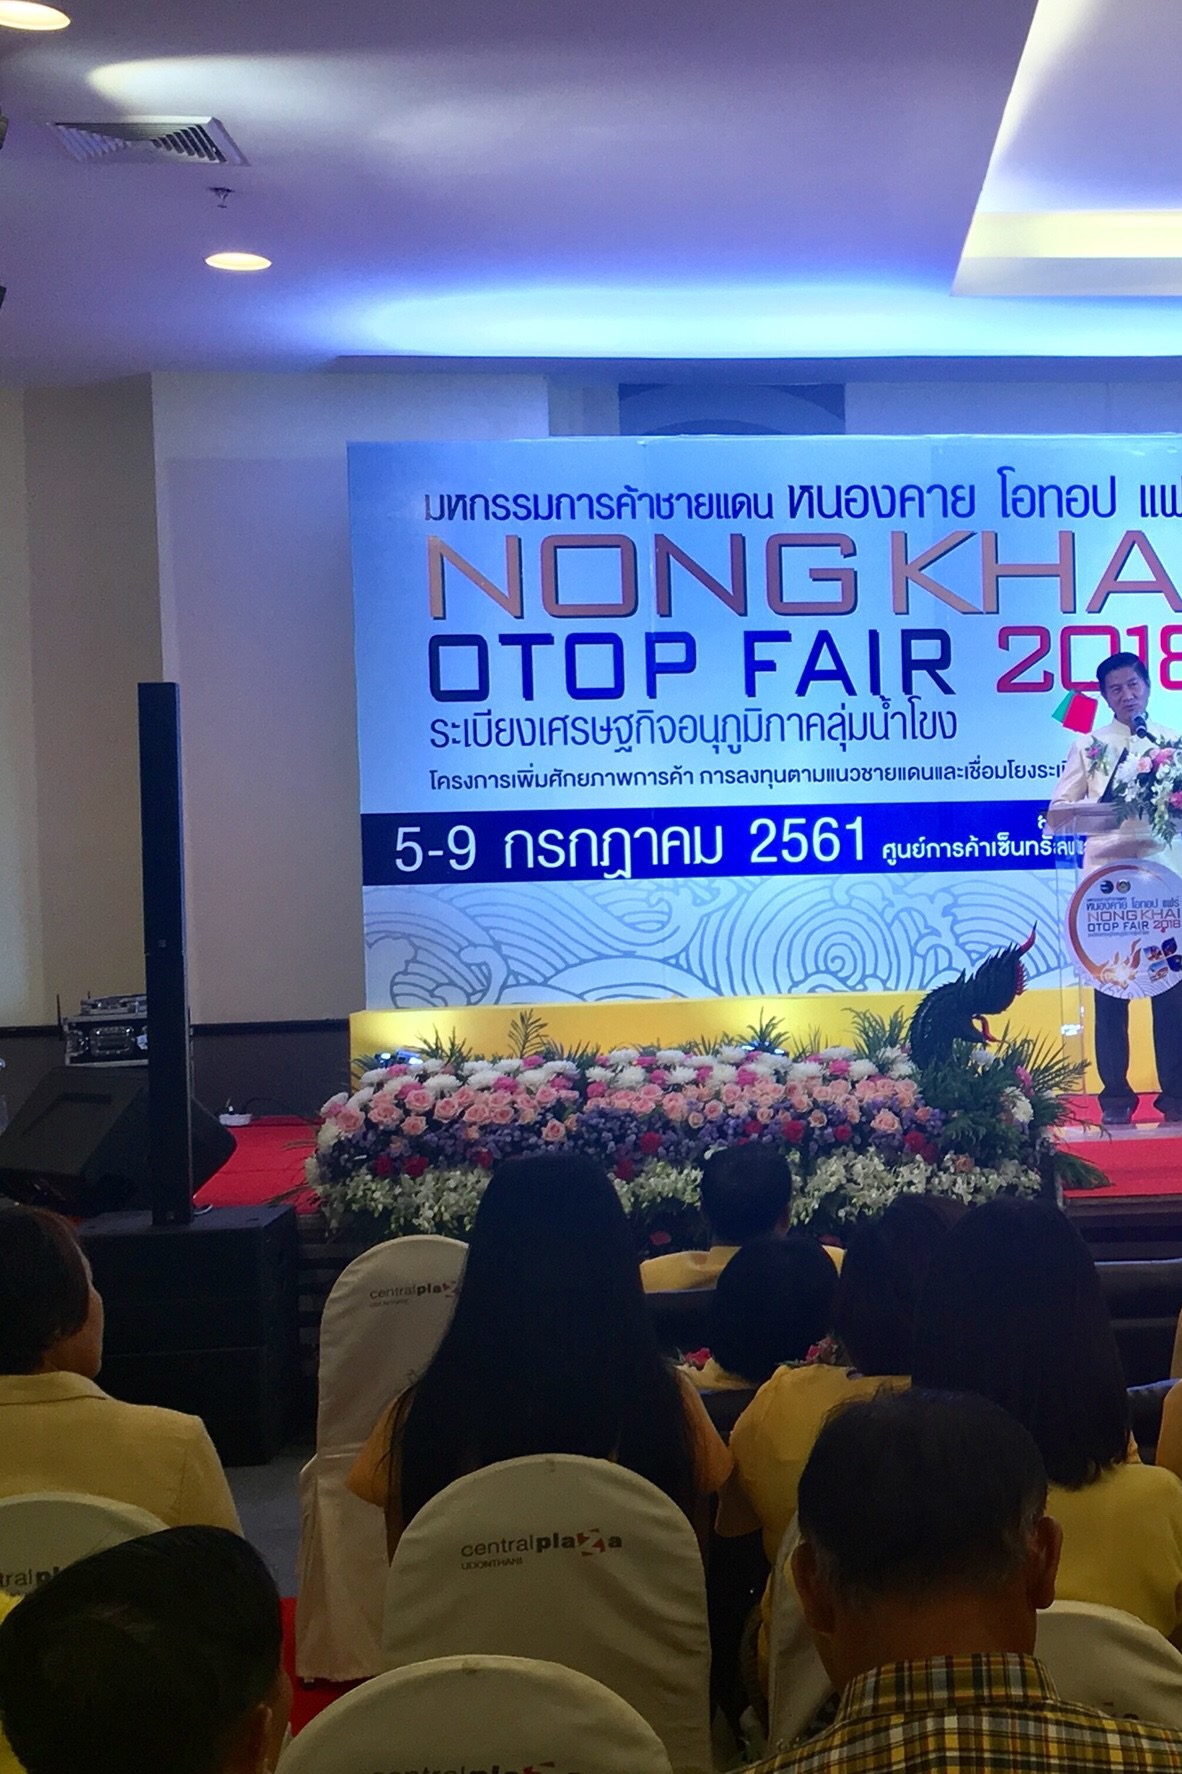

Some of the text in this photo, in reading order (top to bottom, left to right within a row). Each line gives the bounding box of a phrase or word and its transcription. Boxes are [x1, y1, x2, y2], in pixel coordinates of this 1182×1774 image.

[424, 485, 774, 521] มหกรรมการค้าชายแดน
[788, 483, 976, 519] หนองคาย
[997, 466, 1117, 519] โอทอป
[427, 532, 859, 620] NONG
[428, 630, 697, 702] OTOP
[743, 628, 956, 698] FAIR
[430, 695, 957, 754] ระเบียงเศรษฐกิจอนุภูมิภาคลุ่มน้ำโขง
[429, 763, 694, 790] โครงการเพิ่มศักยภาพการค้า
[394, 824, 477, 872] 5-9
[503, 823, 725, 879] กรกฎาคม
[749, 815, 866, 864] 2561
[1087, 908, 1181, 922] NONG KHAI
[1087, 919, 1182, 932] OTOP FAIR 2018
[460, 1528, 623, 1558] centralplaza
